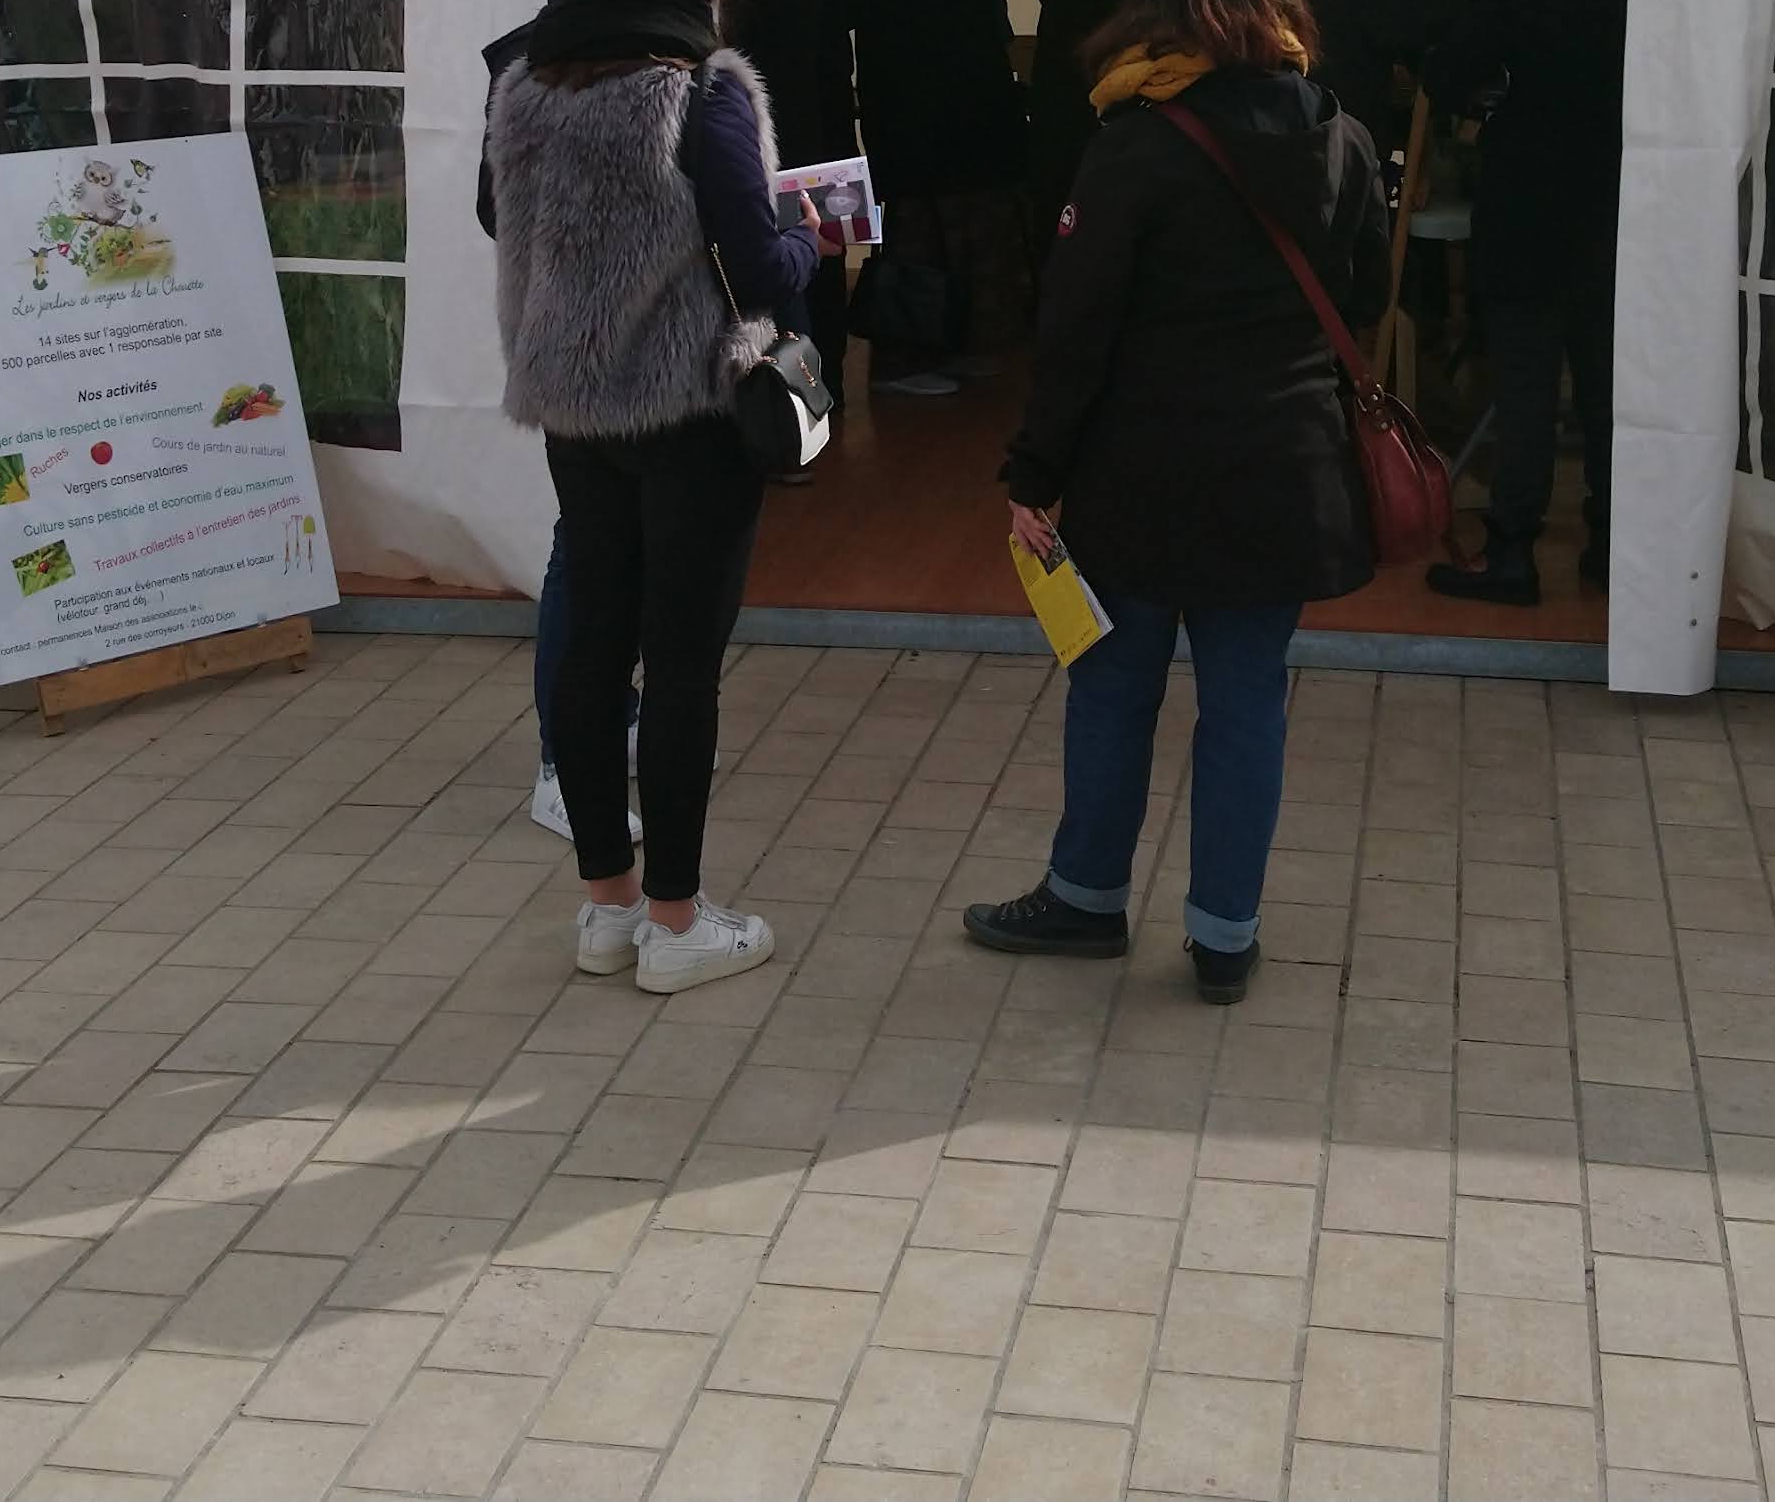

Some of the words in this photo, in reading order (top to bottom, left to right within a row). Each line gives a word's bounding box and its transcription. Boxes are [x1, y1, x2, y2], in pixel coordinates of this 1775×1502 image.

[12, 294, 35, 316] Les
[37, 292, 76, 319] jardins
[94, 291, 127, 310] vergers
[131, 282, 142, 298] de
[146, 281, 157, 296] la
[161, 275, 205, 297] Chouette
[1, 356, 23, 370] 500
[25, 348, 77, 370] parcelles
[79, 344, 106, 358] avec
[109, 342, 115, 354] 1
[117, 333, 182, 356] responsable
[183, 330, 202, 346] par
[202, 326, 223, 339] site
[38, 336, 53, 348] 14
[54, 331, 81, 346] sites
[83, 330, 101, 342] sur
[77, 389, 103, 403] Nos
[105, 379, 158, 399] activités
[16, 430, 44, 445] dans
[46, 427, 57, 440] le
[59, 419, 102, 438] respect
[103, 415, 118, 428] de
[118, 401, 204, 426] l'environnement
[30, 447, 70, 479] Ruches
[152, 436, 184, 451] Cours
[186, 439, 201, 451] de
[202, 441, 233, 457] jardin
[234, 445, 249, 455] au
[250, 444, 287, 458] naturel
[64, 479, 109, 497] Vergers
[110, 462, 189, 487] conservatoires
[24, 519, 65, 537] Culture
[67, 515, 95, 528] sans
[97, 504, 146, 525] pesticide
[148, 500, 160, 513] et
[161, 490, 213, 509] économie
[214, 484, 243, 499] d'eau
[245, 474, 295, 493] maximum
[94, 550, 139, 572] Travaux
[139, 534, 185, 556] collectifs
[196, 513, 246, 538] l'entretien
[248, 505, 266, 520] des
[54, 588, 114, 612] Participation
[115, 584, 133, 597] aux
[133, 571, 191, 593] événements
[191, 562, 236, 579] nationaux
[236, 558, 246, 571] et
[246, 553, 276, 567] locaux
[103, 598, 131, 615] grand
[37, 627, 93, 649] permanences
[93, 619, 124, 634] Maison
[124, 616, 140, 628] des
[140, 606, 188, 625] associations
[104, 639, 112, 648] 2
[112, 635, 127, 646] rue
[127, 631, 143, 643] des
[143, 622, 185, 641] corroyeurs
[191, 614, 215, 629] 21000
[216, 610, 236, 624] Dijon
